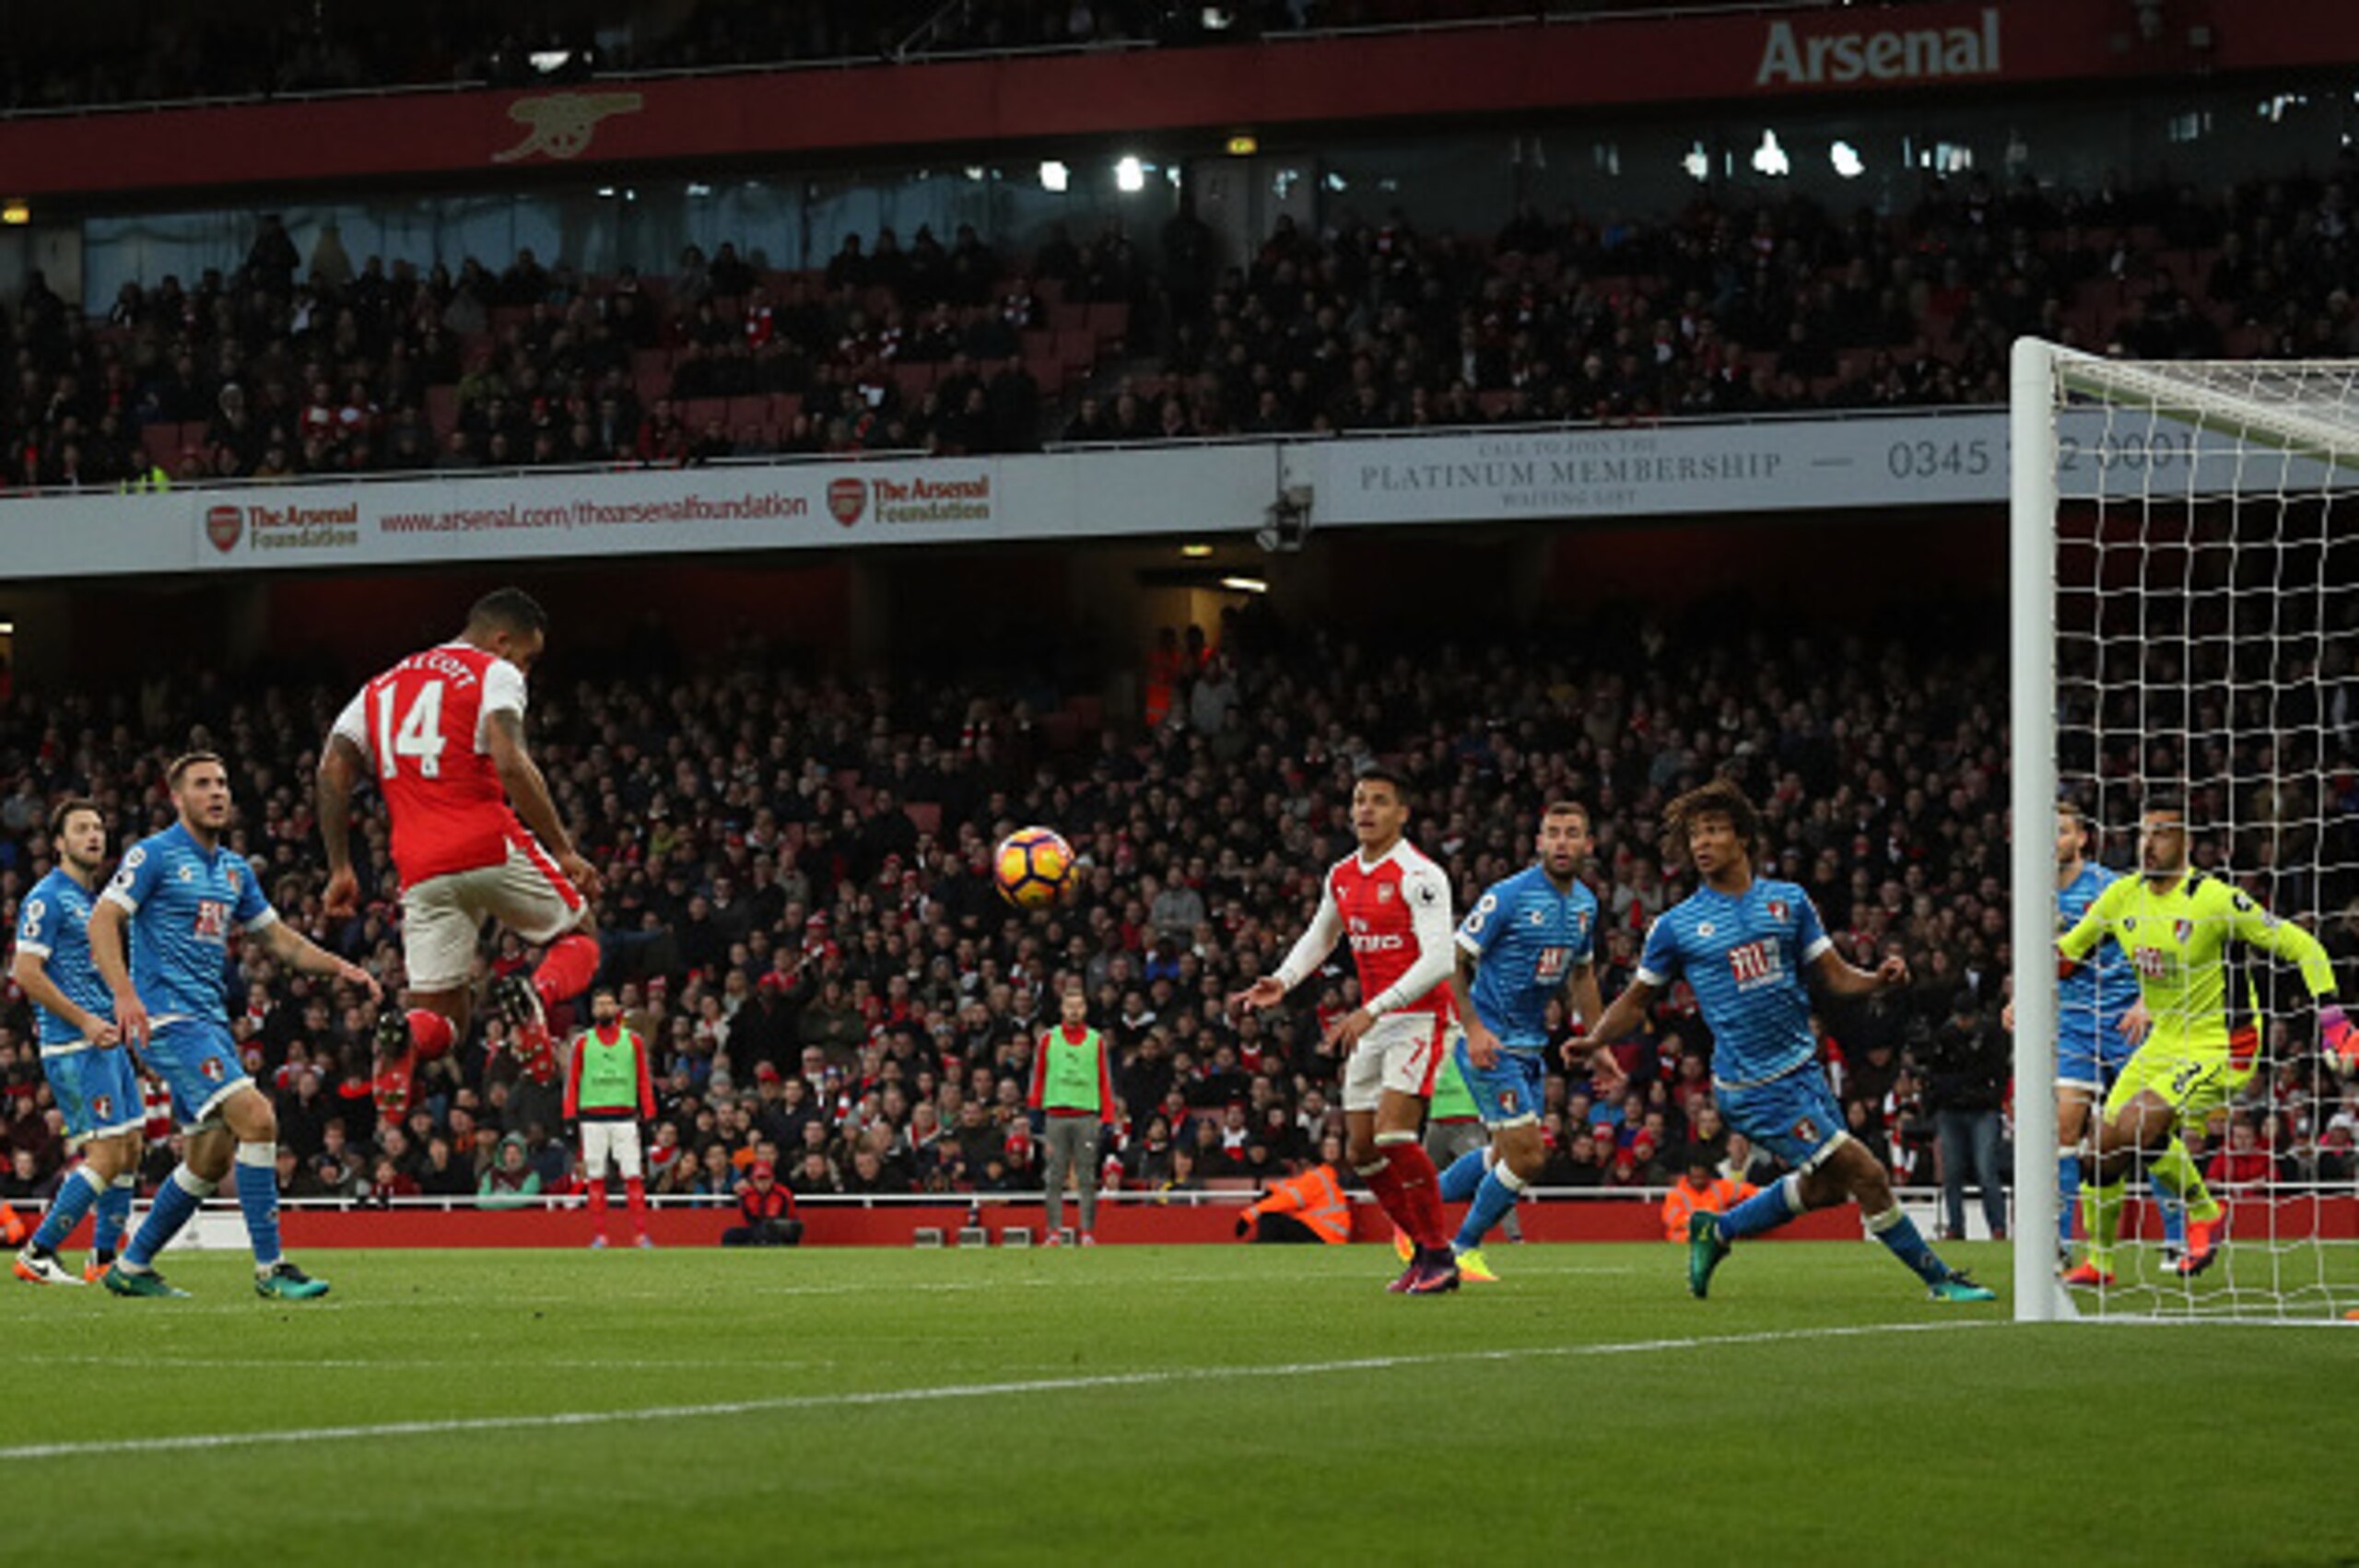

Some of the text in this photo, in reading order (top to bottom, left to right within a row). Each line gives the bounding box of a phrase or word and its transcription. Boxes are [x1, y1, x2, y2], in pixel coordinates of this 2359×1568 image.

[1755, 8, 2000, 85] Arsenal
[1361, 453, 1780, 491] PLATINUM MEMBERSHIP
[1886, 439, 1989, 479] 0345
[871, 474, 991, 500] The Arsenal
[248, 501, 358, 528] The Arsenal
[874, 502, 990, 523] Foundation
[250, 528, 358, 550] Foundation
[377, 679, 448, 779] 14
